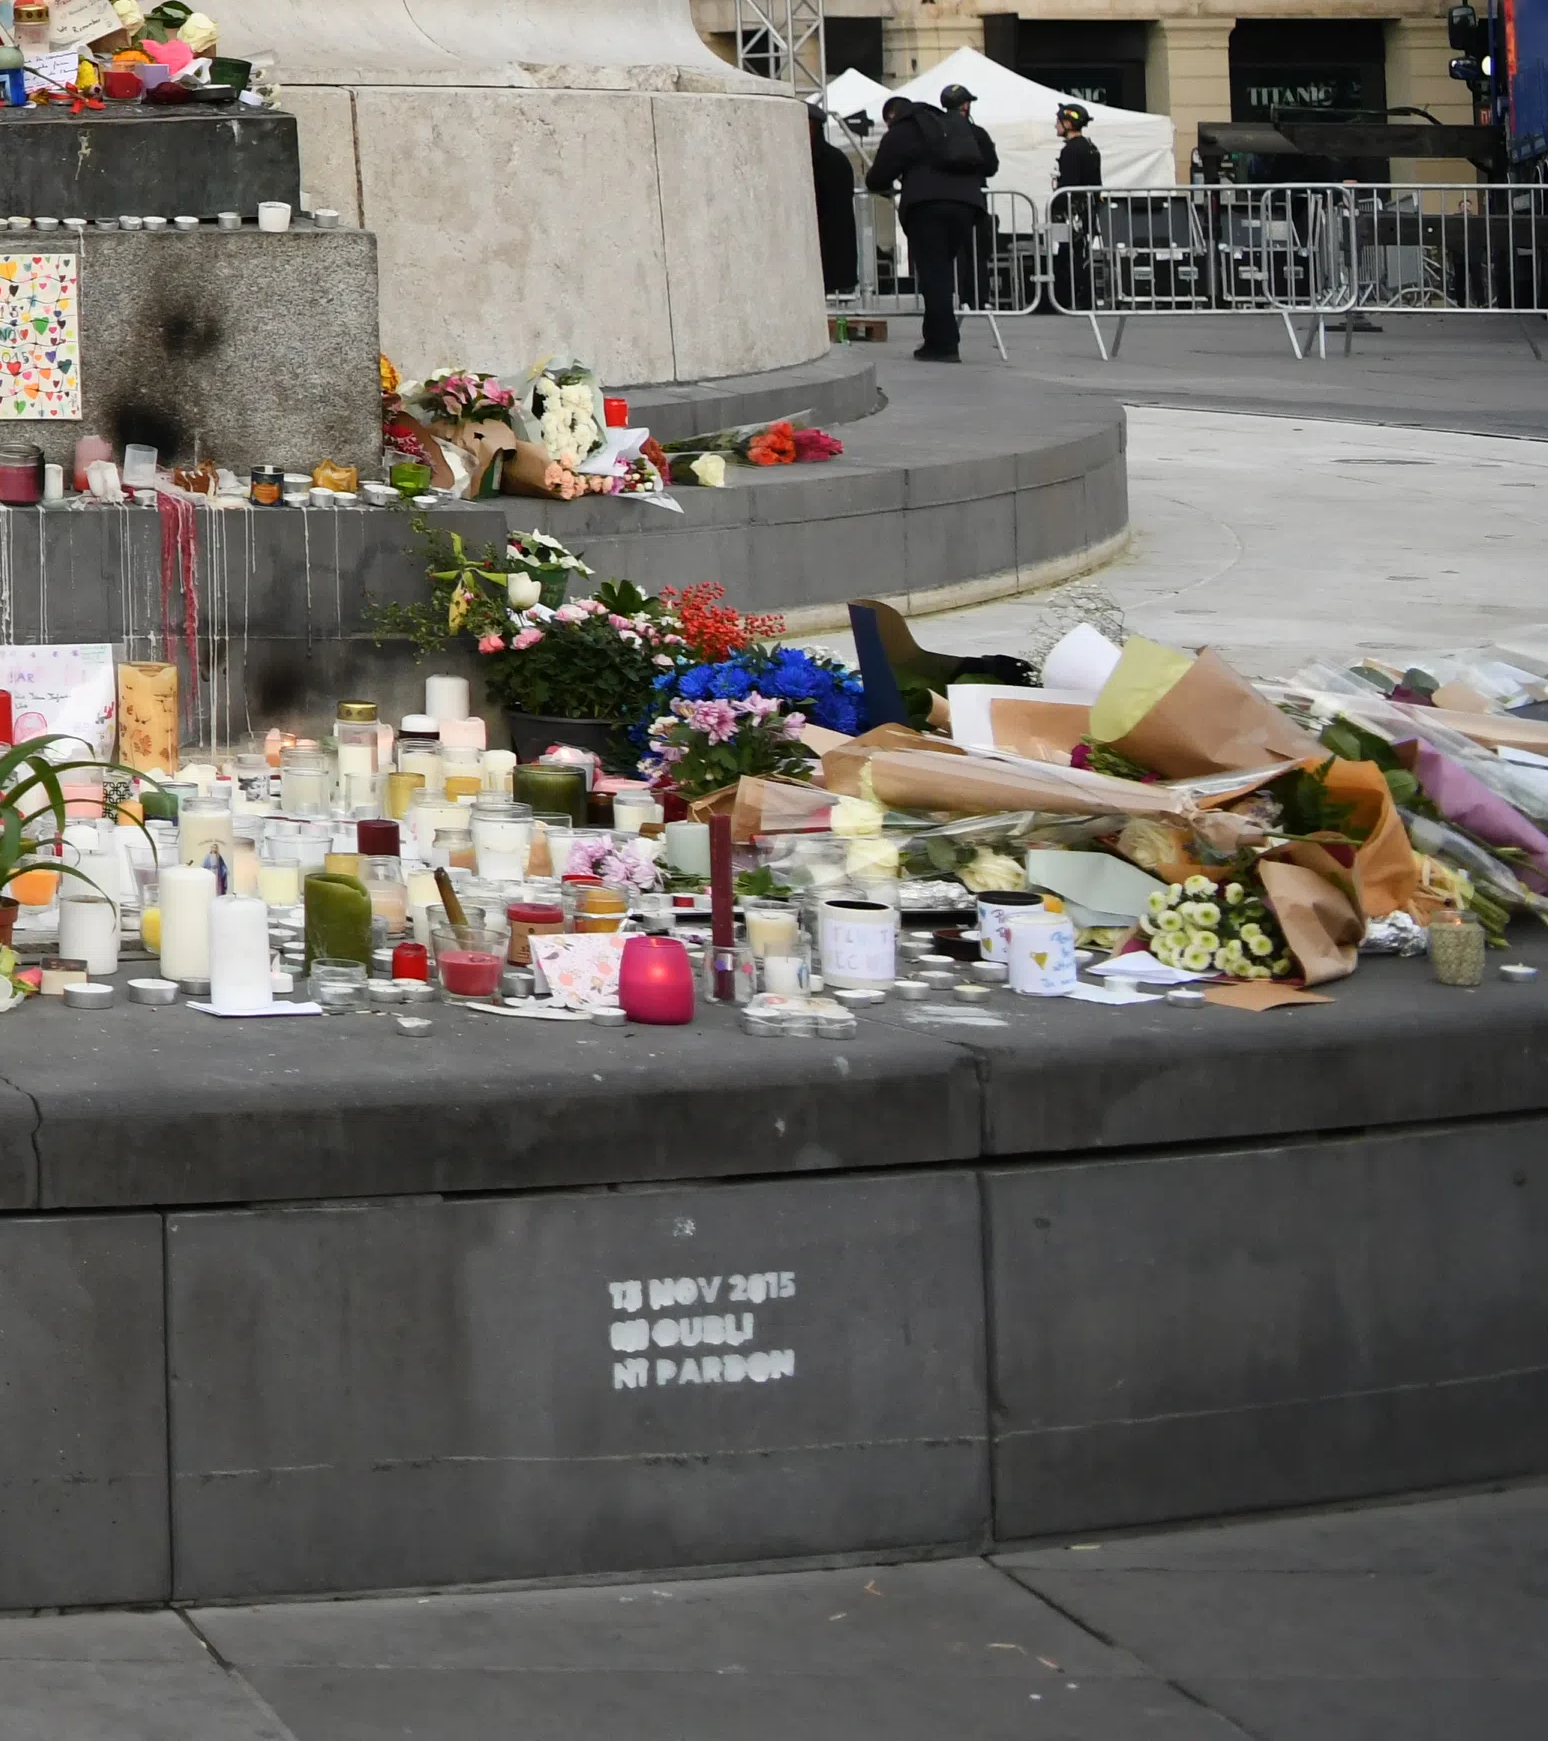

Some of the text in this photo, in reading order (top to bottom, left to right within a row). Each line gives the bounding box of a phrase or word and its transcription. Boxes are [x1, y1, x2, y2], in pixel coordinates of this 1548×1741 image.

[1247, 87, 1335, 106] TITANIC
[649, 1275, 723, 1310] NOV
[728, 1271, 796, 1304] 2015
[652, 1312, 754, 1347] OUBLI
[656, 1349, 795, 1386] PARDON
